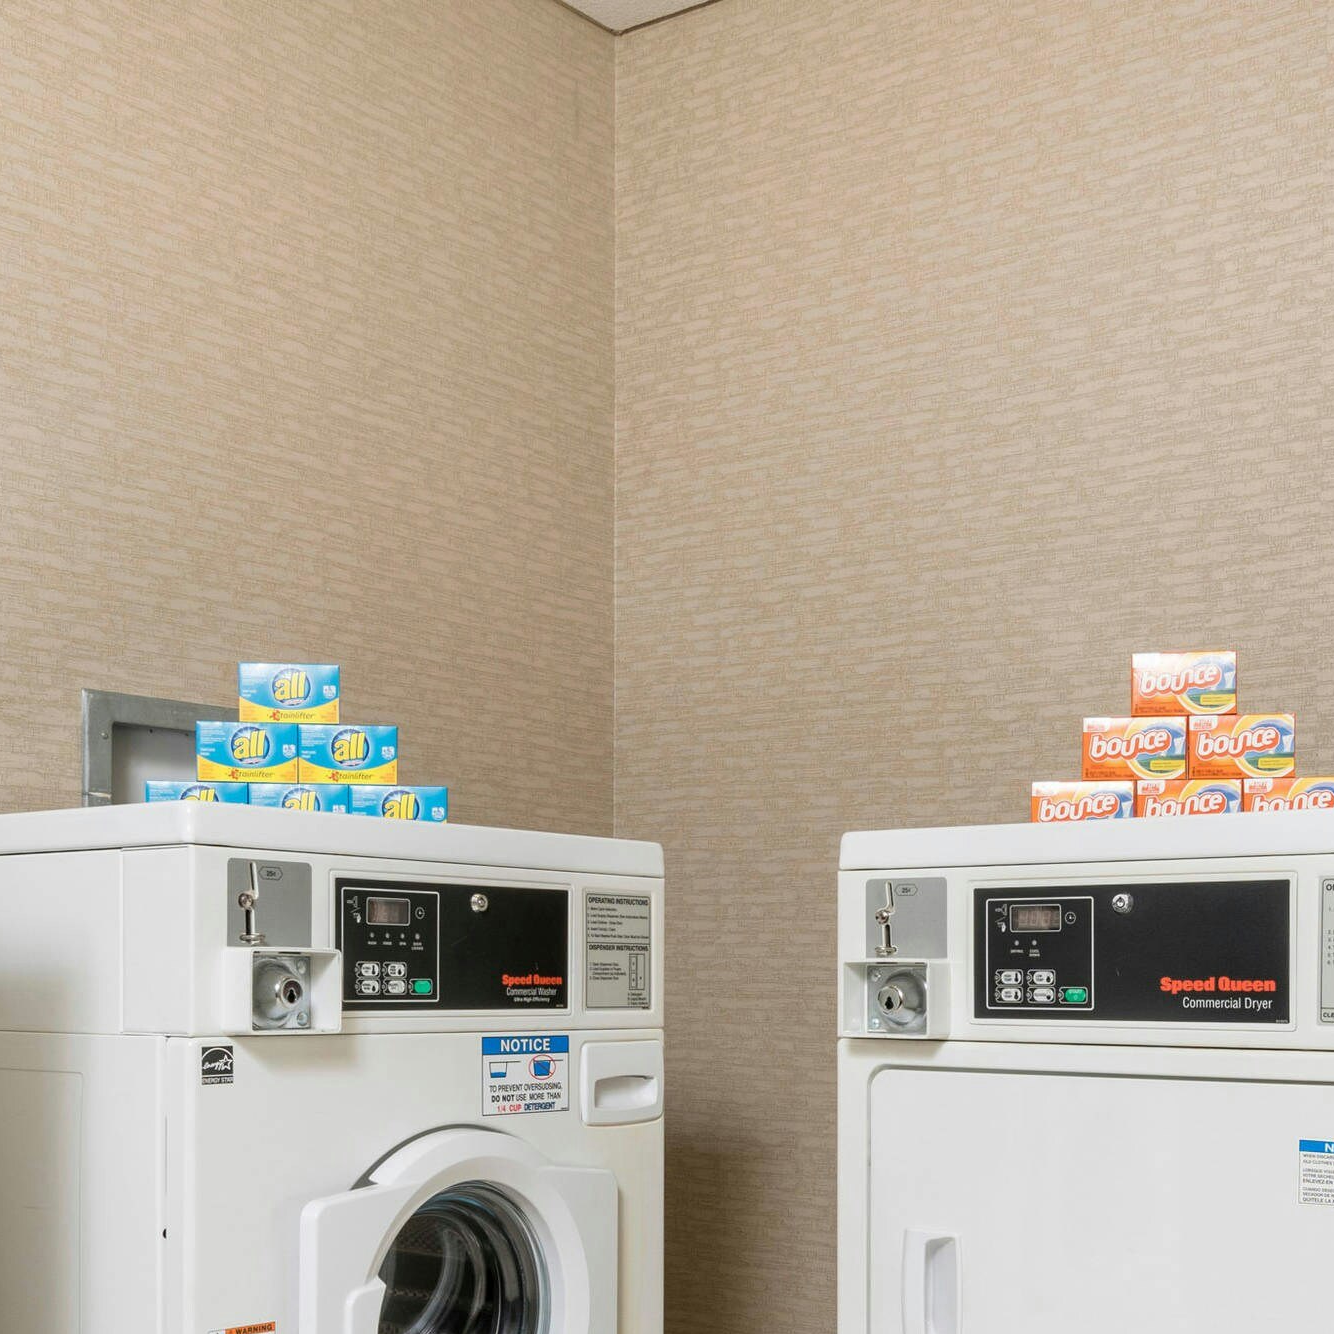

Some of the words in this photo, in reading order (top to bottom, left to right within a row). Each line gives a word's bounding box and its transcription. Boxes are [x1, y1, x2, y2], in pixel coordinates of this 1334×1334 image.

[274, 672, 306, 700] all
[1140, 664, 1221, 696] bounce
[233, 730, 266, 759] all
[333, 733, 365, 762] all
[1090, 730, 1171, 761] bounce
[1197, 728, 1279, 759] bounce
[384, 794, 415, 820] all
[1039, 794, 1118, 822] bounce
[1145, 792, 1226, 816] bounce
[588, 896, 615, 904] OPERATING
[616, 898, 648, 906] INSTRUCTIONS
[502, 974, 532, 986] Speed
[533, 974, 562, 984] Queen
[507, 987, 537, 996] Commercial
[1160, 977, 1215, 994] Speed
[1218, 976, 1276, 992] Queen
[1183, 996, 1241, 1009] Commercial
[1245, 997, 1272, 1011] Dryer
[500, 1038, 551, 1052] NOTICE
[524, 1102, 555, 1110] DETERGENT
